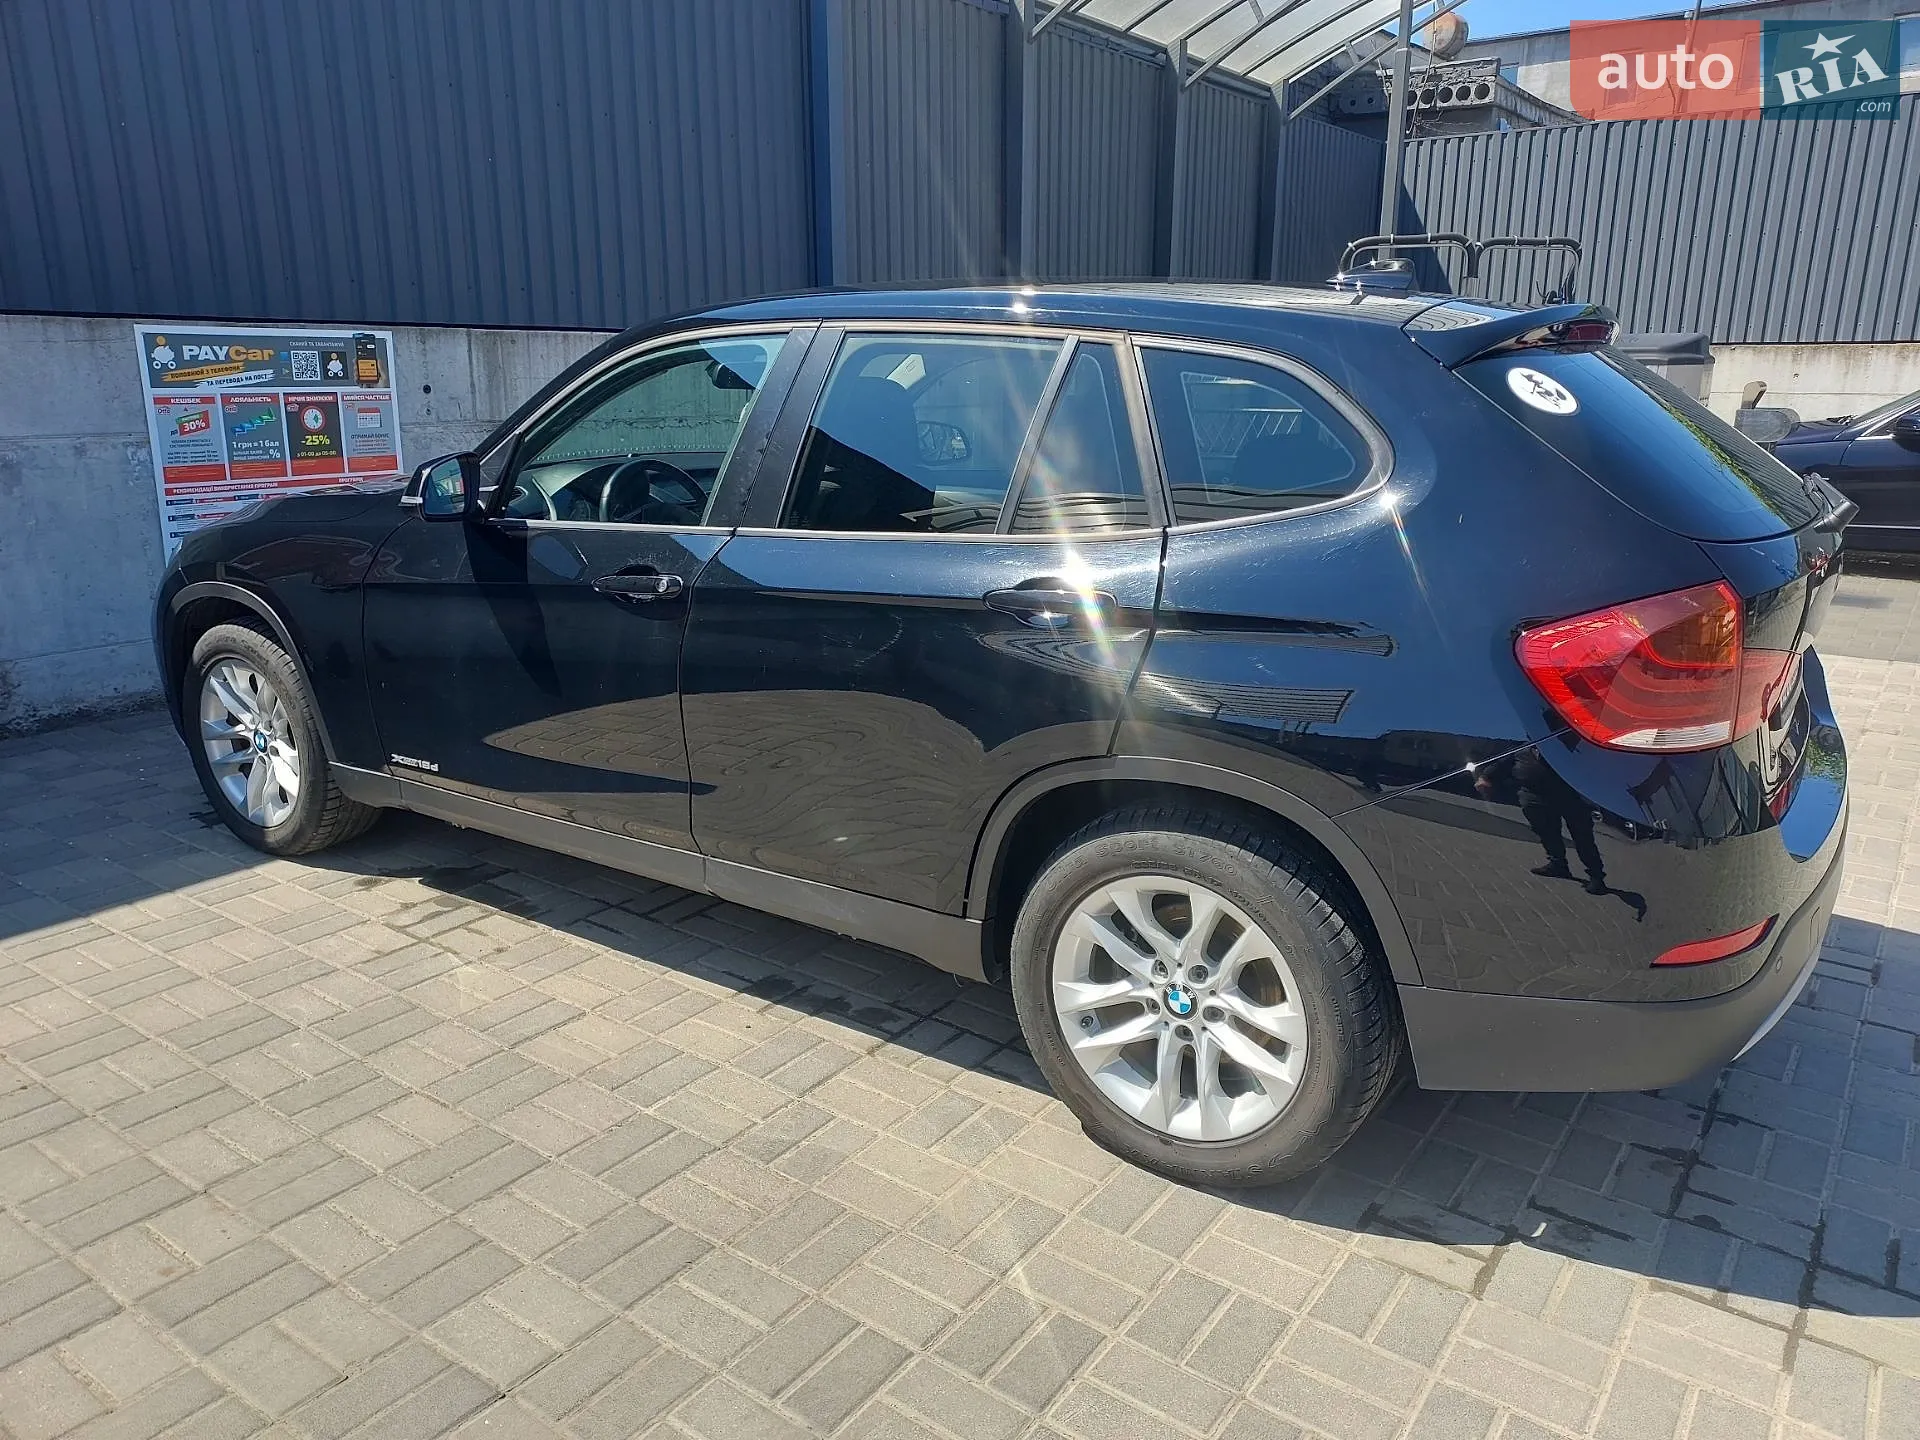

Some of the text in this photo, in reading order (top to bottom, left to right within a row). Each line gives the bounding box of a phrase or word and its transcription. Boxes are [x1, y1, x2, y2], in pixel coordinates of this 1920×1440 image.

[182, 345, 275, 361] PAYCar
[183, 418, 206, 432] 30%
[301, 434, 330, 445] -25%
